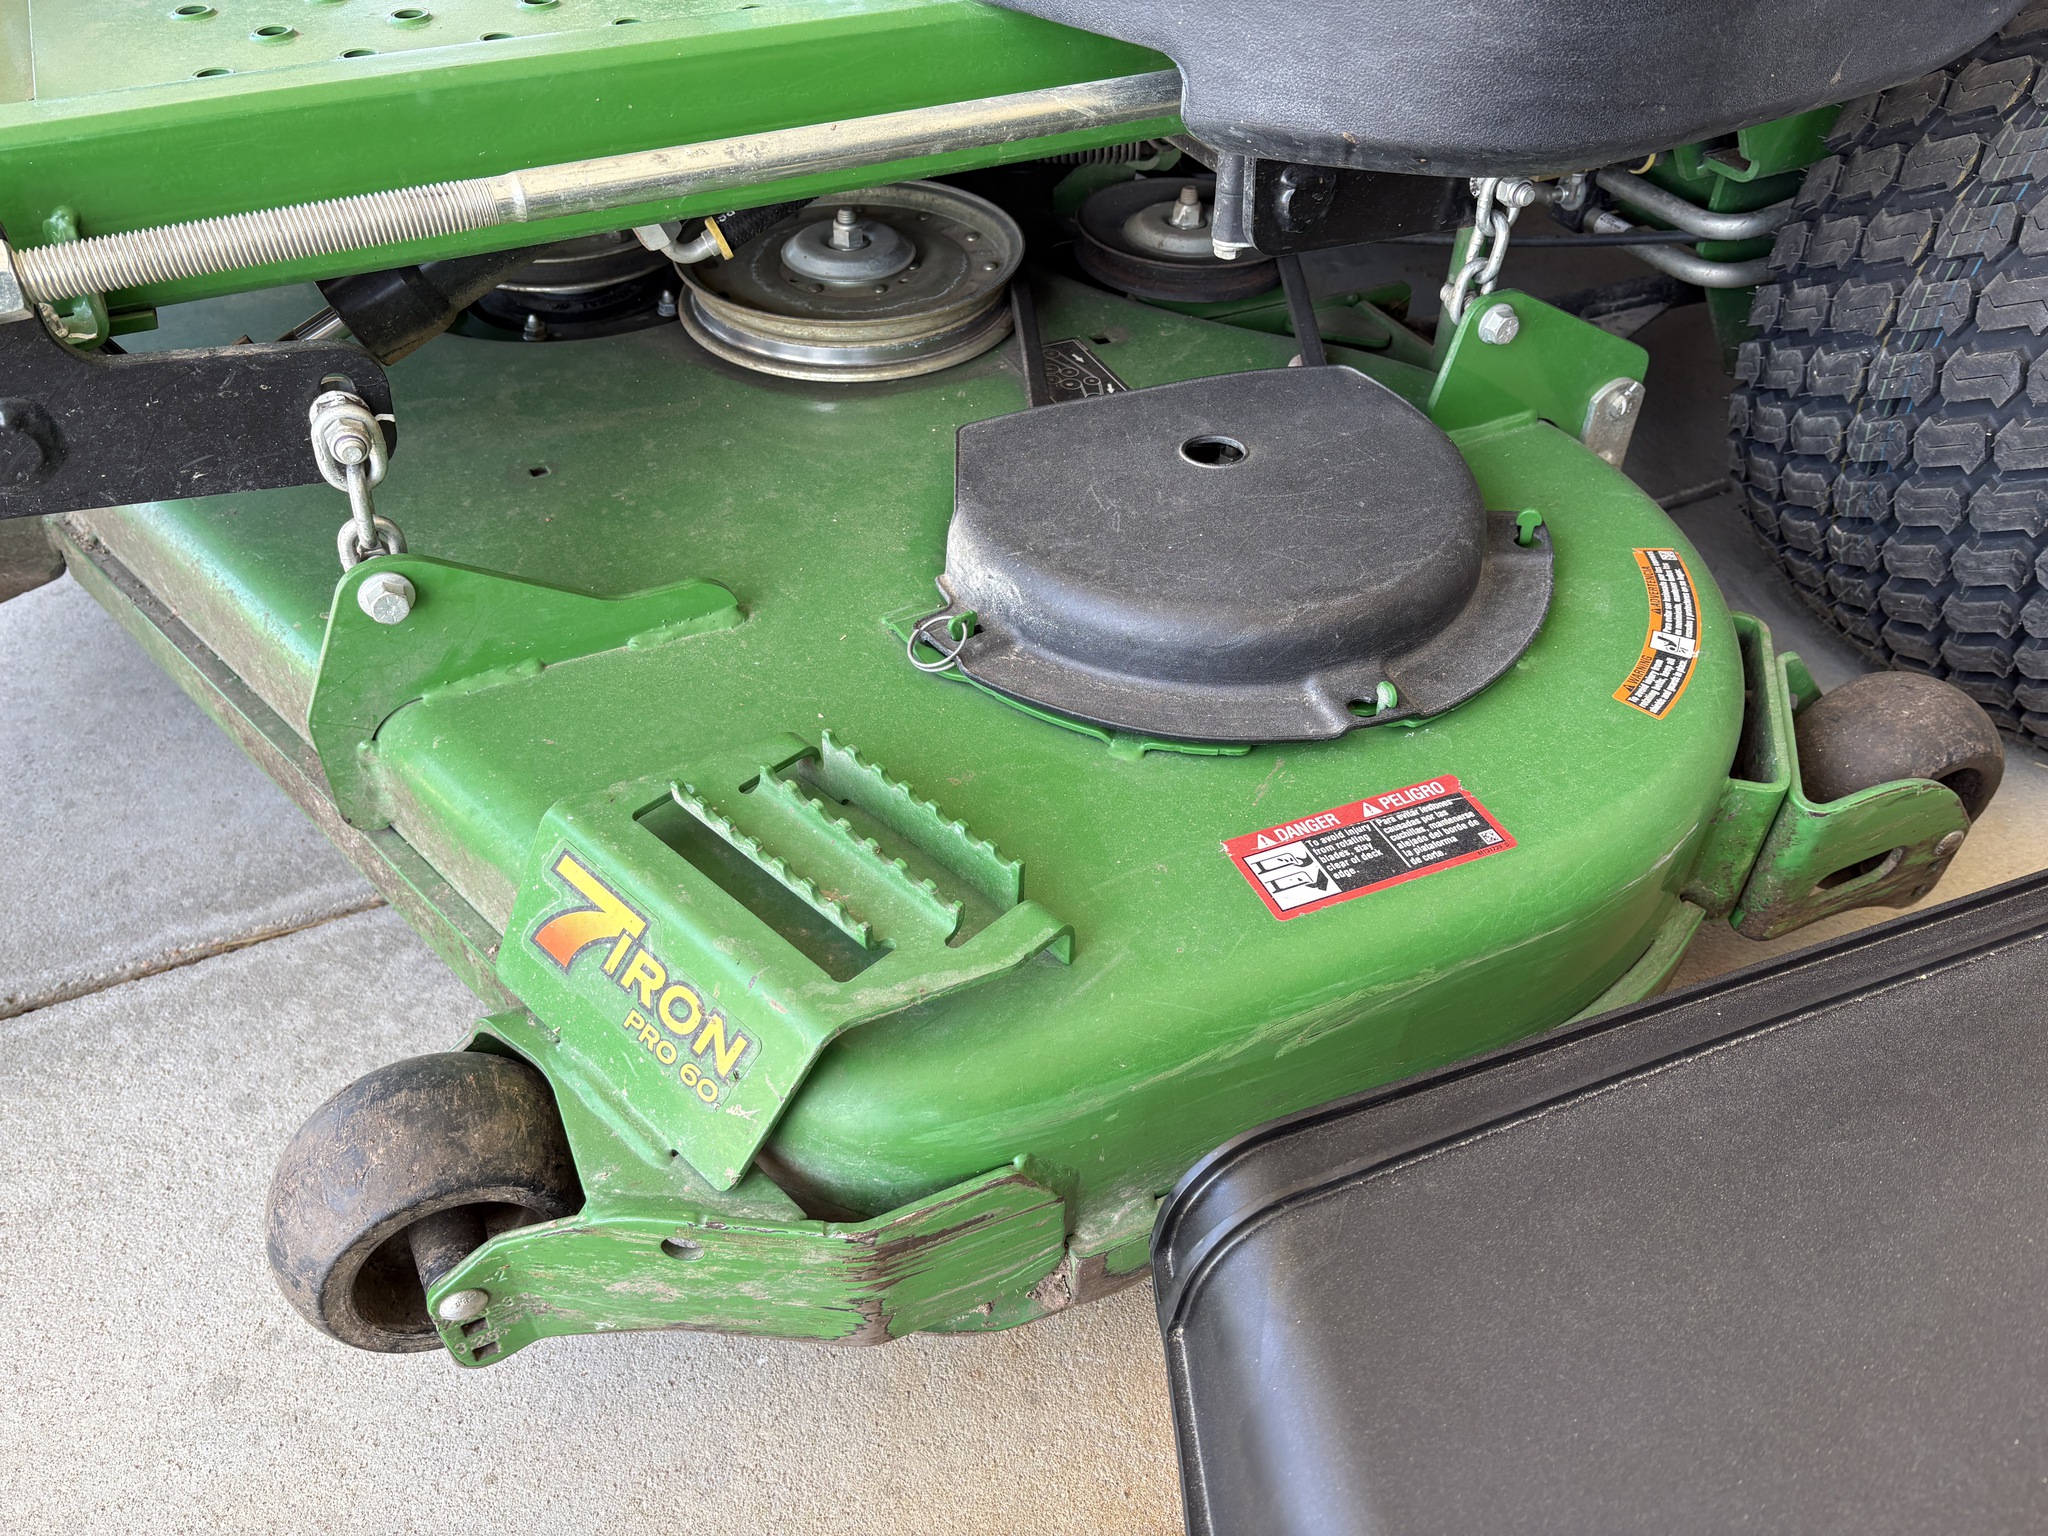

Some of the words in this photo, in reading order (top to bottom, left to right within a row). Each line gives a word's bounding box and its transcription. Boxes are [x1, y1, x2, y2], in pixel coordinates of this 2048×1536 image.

[1641, 566, 1661, 606] ADVERTENCIA
[1627, 655, 1653, 687] WARNING
[1378, 781, 1445, 810] PELIGRO
[1376, 816, 1397, 827] Para
[1398, 807, 1420, 820] evitar
[1419, 799, 1453, 814] lesiones
[1383, 817, 1421, 834] causadas
[1420, 814, 1434, 825] por
[1434, 809, 1449, 819] las
[1273, 813, 1341, 842] DANGER
[1305, 839, 1320, 848] To
[1319, 830, 1345, 844] avoid
[1345, 823, 1372, 837] injury
[1389, 826, 1430, 842] cuchillas,
[1428, 811, 1475, 830] mantenerse
[1396, 834, 1429, 850] alejado
[1428, 829, 1444, 840] del
[1444, 822, 1468, 836] borde
[1467, 819, 1480, 828] de
[1312, 844, 1335, 856] from
[1335, 833, 1372, 851] rotating
[1318, 848, 1354, 863] blades,
[1354, 842, 1375, 853] stay
[1402, 848, 1413, 857] la
[1413, 836, 1459, 857] plataforma
[1409, 856, 1422, 866] de
[1422, 849, 1447, 861] corte.
[1327, 858, 1350, 872] clear
[1352, 854, 1361, 864] of
[1361, 848, 1383, 861] deck
[1332, 868, 1360, 880] edge.
[622, 1008, 678, 1066] PRO
[679, 1062, 719, 1103] 60
